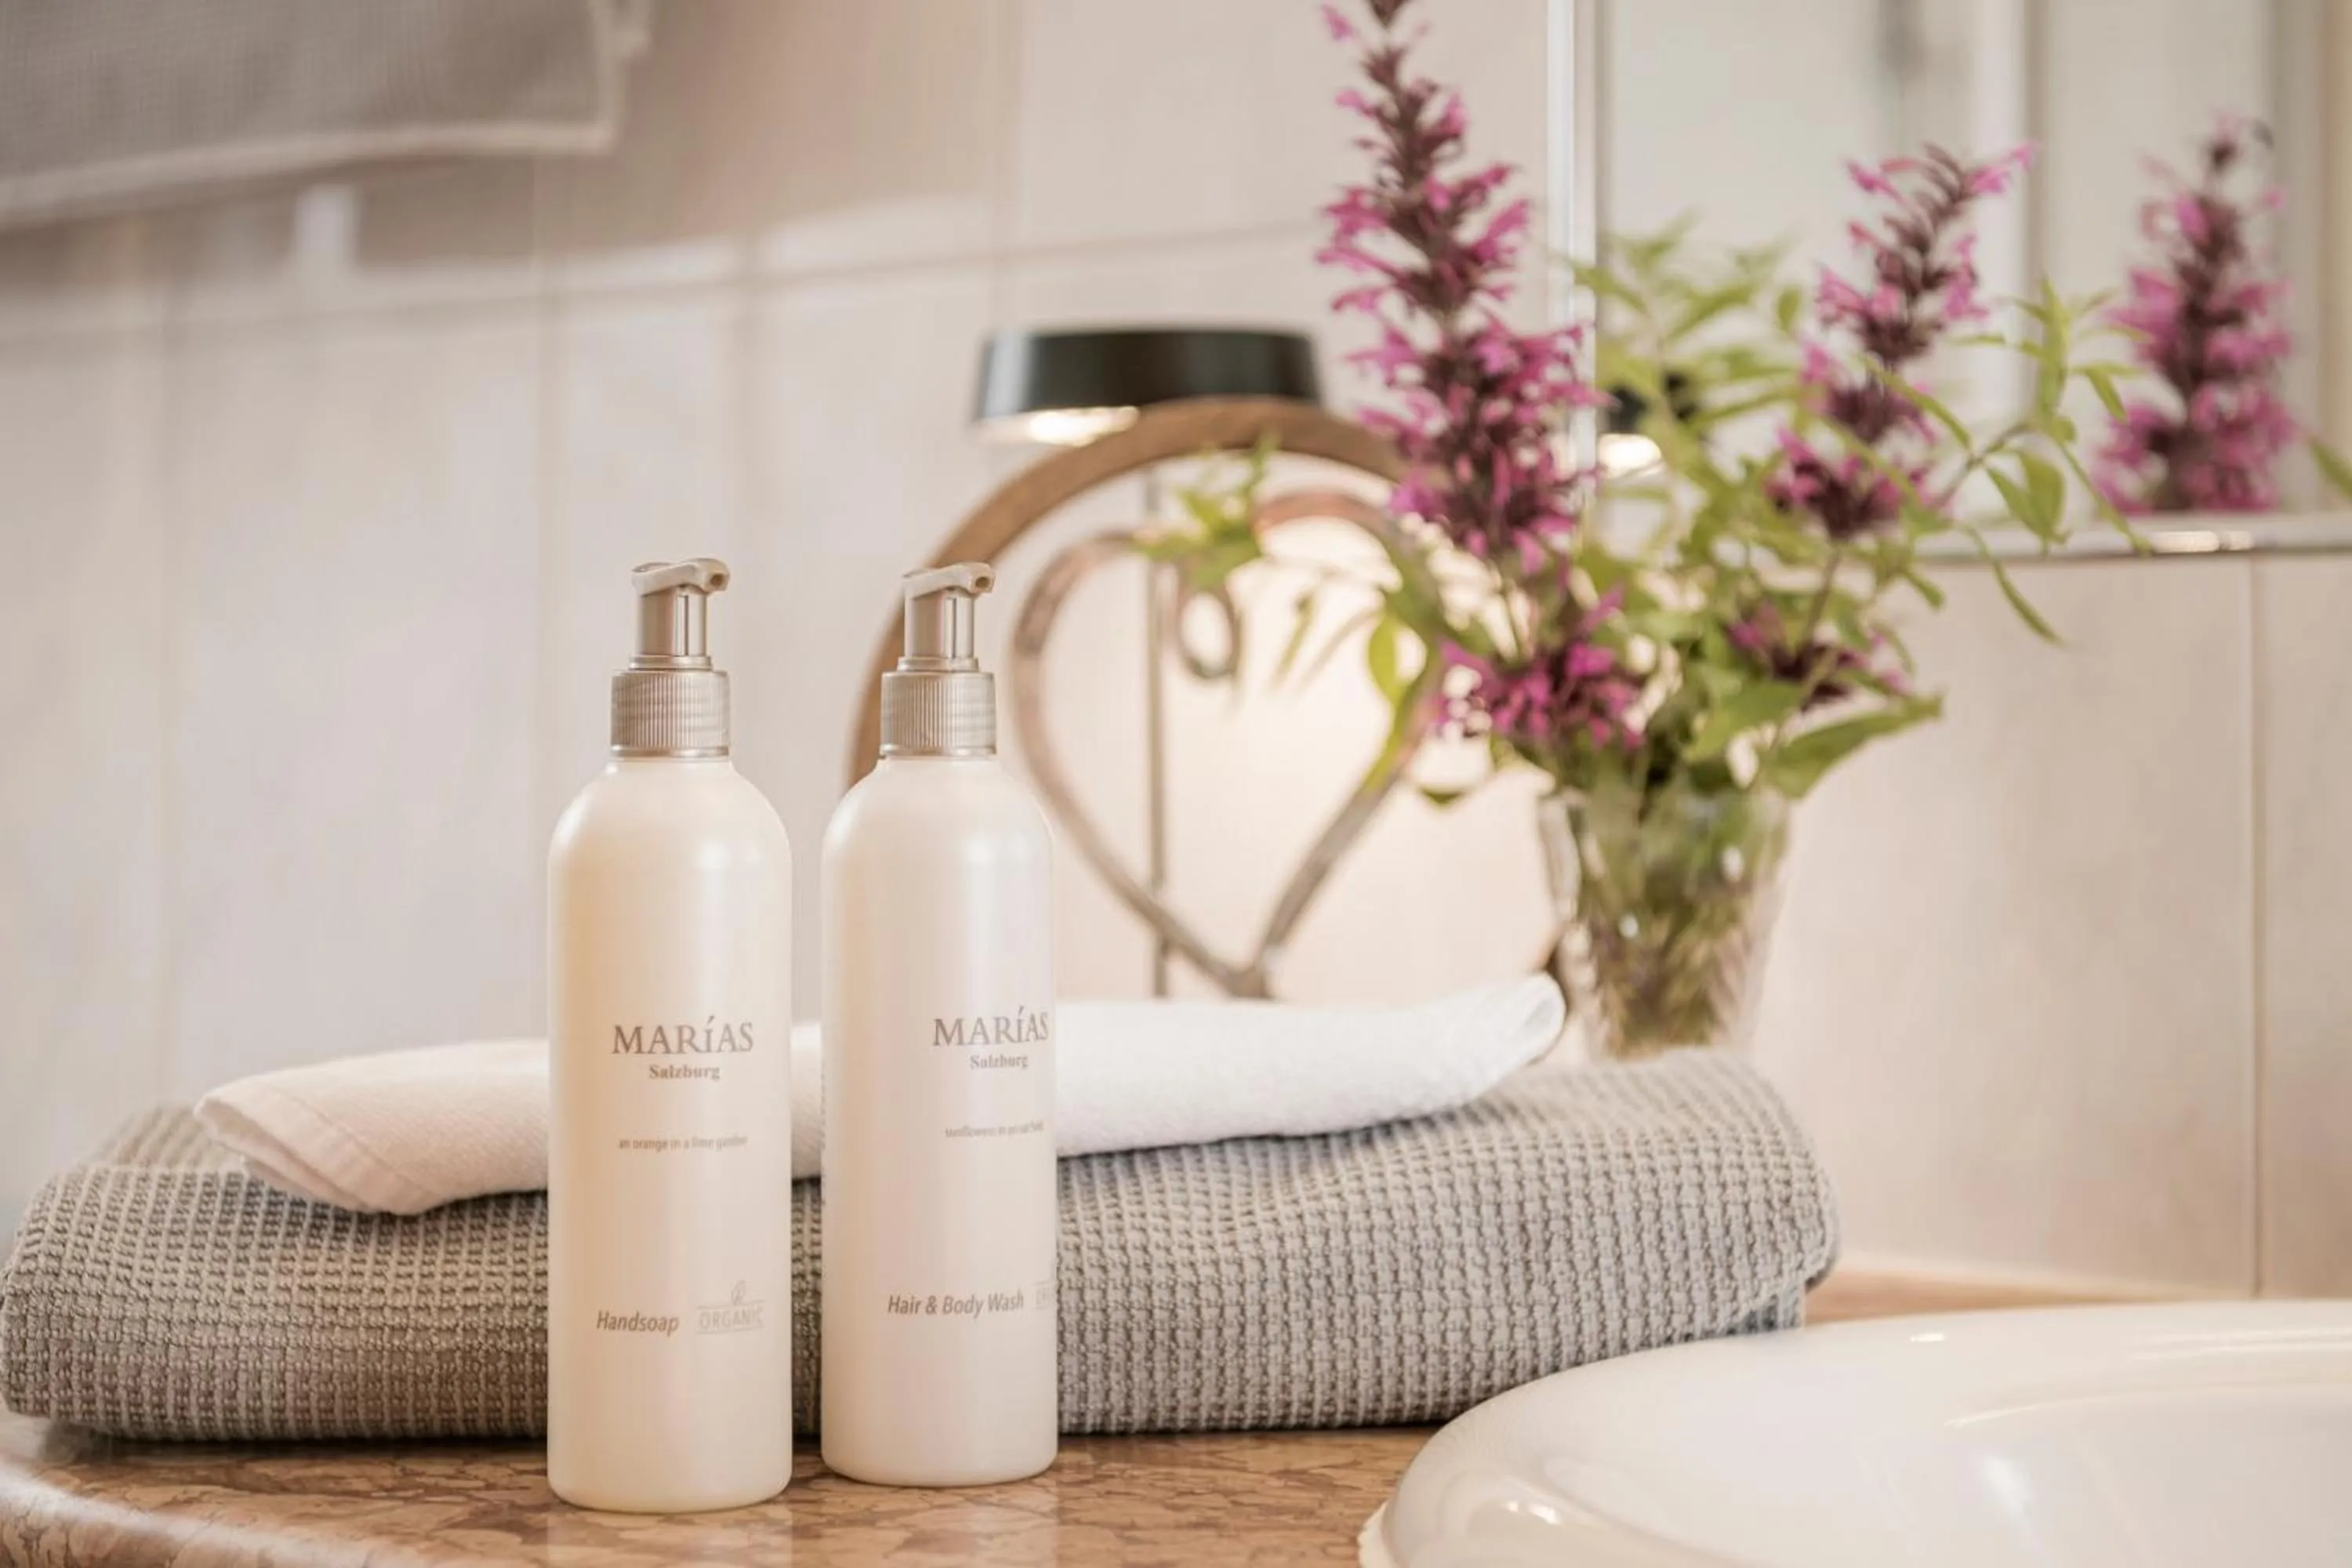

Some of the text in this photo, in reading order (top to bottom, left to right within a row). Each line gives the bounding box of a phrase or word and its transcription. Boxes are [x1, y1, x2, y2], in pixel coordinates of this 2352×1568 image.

[648, 1063, 720, 1081] Salzburg
[970, 1054, 1029, 1070] Salzburg
[633, 1138, 668, 1152] orange
[887, 1294, 921, 1316] Hair
[924, 1295, 938, 1316] &
[942, 1294, 984, 1320] Body
[987, 1288, 1025, 1312] Wash
[596, 1309, 680, 1338] Handsoap
[698, 1305, 764, 1330] ORGANIC
